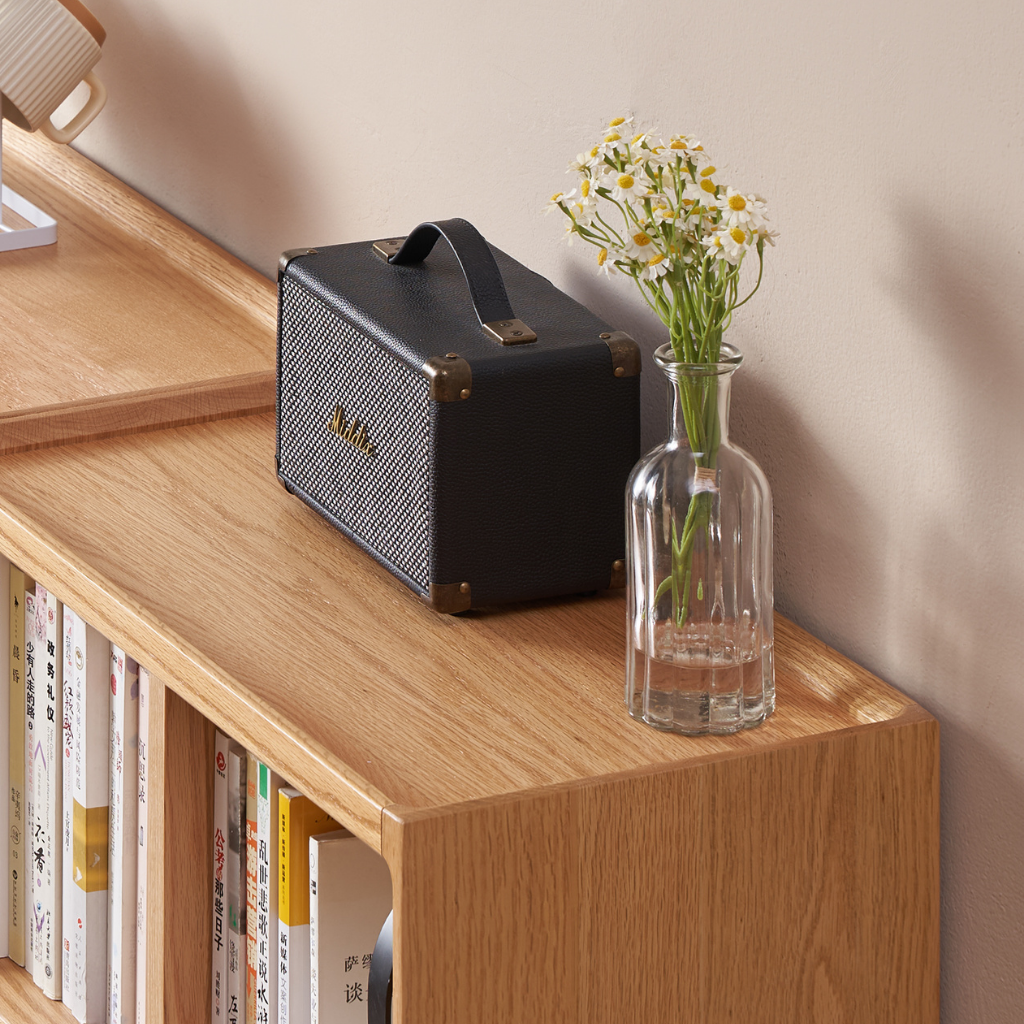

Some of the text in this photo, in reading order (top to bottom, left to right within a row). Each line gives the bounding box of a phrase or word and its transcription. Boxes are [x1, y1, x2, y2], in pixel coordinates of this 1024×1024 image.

[26, 641, 35, 720] 少有人走的路
